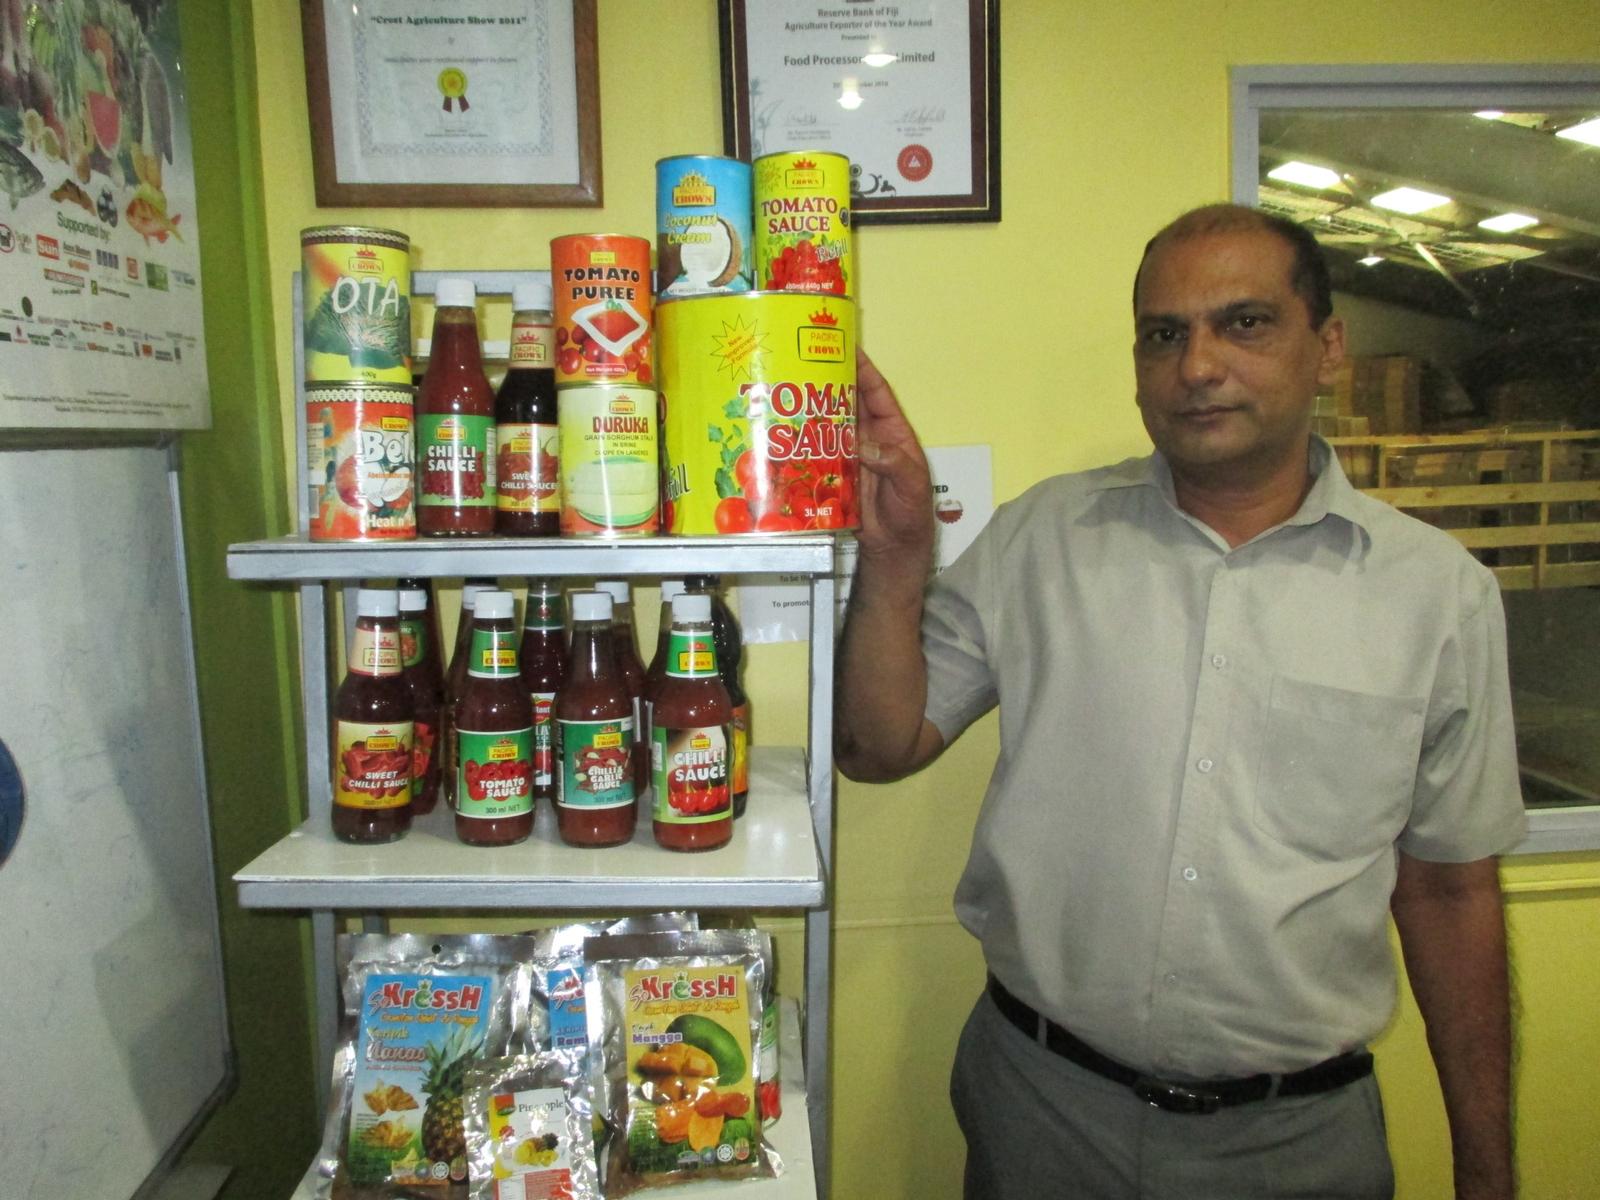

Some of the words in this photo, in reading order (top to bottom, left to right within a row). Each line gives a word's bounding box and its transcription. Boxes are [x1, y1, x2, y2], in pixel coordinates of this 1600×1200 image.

[817, 9, 850, 17] Reserve
[852, 8, 874, 17] Bank
[876, 7, 885, 16] of
[886, 7, 899, 18] Fiji
[406, 15, 465, 26] Agriculture
[467, 16, 495, 25] Show
[784, 22, 827, 32] Agriculture
[830, 20, 863, 30] Exporter
[864, 20, 873, 29] of
[874, 19, 887, 28] the
[889, 18, 906, 27] Year
[907, 18, 932, 27] Award
[784, 55, 810, 66] Food
[761, 197, 838, 217] TOMATO
[57, 211, 99, 239] Supported
[769, 216, 831, 234] SAUCE
[564, 267, 640, 283] TOMATO
[332, 276, 400, 317] OTA
[572, 286, 635, 301] PUREE
[808, 345, 841, 355] CROWN
[592, 416, 649, 433] DURUKA
[427, 445, 476, 458] CHILLI
[427, 459, 476, 472] SAUCE
[501, 481, 525, 489] CHILLI
[804, 508, 816, 517] 3L
[817, 507, 833, 516] NET
[674, 749, 725, 766] CHILLI
[365, 771, 398, 780] SWEET
[588, 767, 616, 776] CHILLI
[675, 764, 726, 783] SAUCE
[348, 779, 381, 789] CHILLI
[479, 777, 525, 789] TOMATO
[590, 774, 623, 783] GARLIC
[592, 780, 621, 791] SAUCE
[486, 787, 522, 797] SAUCE
[508, 804, 520, 812] NET
